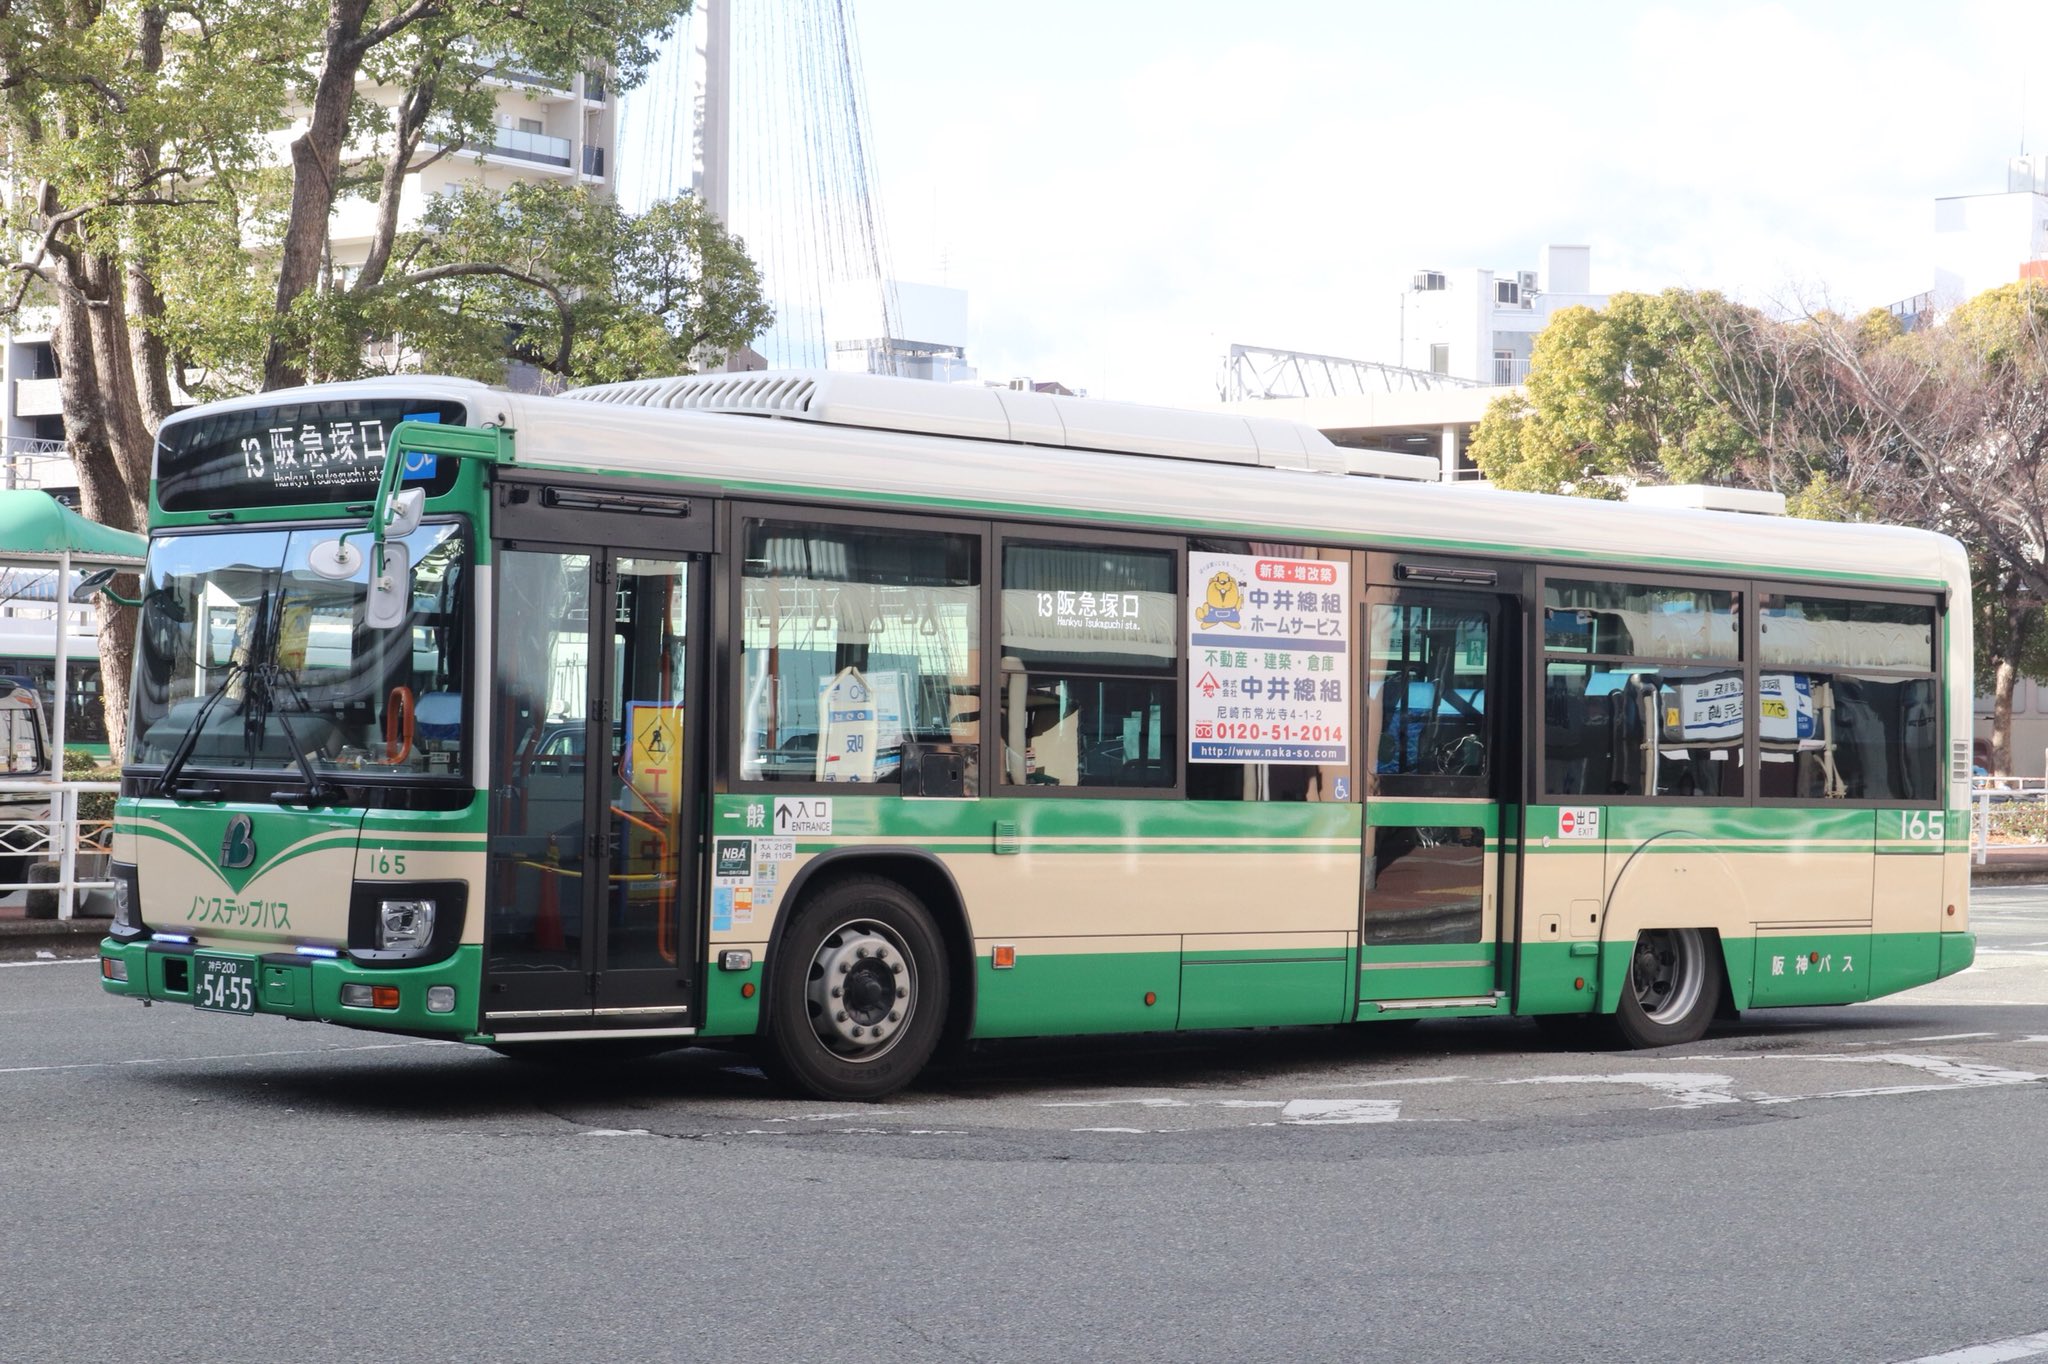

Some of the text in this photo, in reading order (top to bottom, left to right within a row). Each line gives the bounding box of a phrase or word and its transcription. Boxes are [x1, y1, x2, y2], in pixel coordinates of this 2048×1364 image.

[241, 420, 386, 478] 13 阪急塚口
[273, 472, 308, 488] Hankyu
[310, 467, 367, 486] Tsukaguchi
[1260, 564, 1332, 582] 新築・増改築
[1037, 591, 1139, 618] 13 阪急塚口
[1057, 617, 1141, 631] Hankyu Tsukaguchi sta.
[1251, 615, 1342, 636] ホームサービス
[1205, 650, 1334, 672] 不動産・建築・倉庫
[1217, 723, 1342, 742] 0120-51-2014
[1201, 746, 1337, 759] http://www.naka-so.com
[724, 804, 765, 828] 一般
[797, 802, 826, 818] 入口
[1576, 810, 1597, 825] 出口
[792, 822, 830, 832] ENTRANCE
[1578, 827, 1594, 836] EXIT
[1901, 810, 1945, 840] 165
[370, 853, 406, 875] 165
[722, 847, 747, 860] NBA
[186, 895, 291, 930] ノンステップバス
[204, 974, 252, 1011] 54-55
